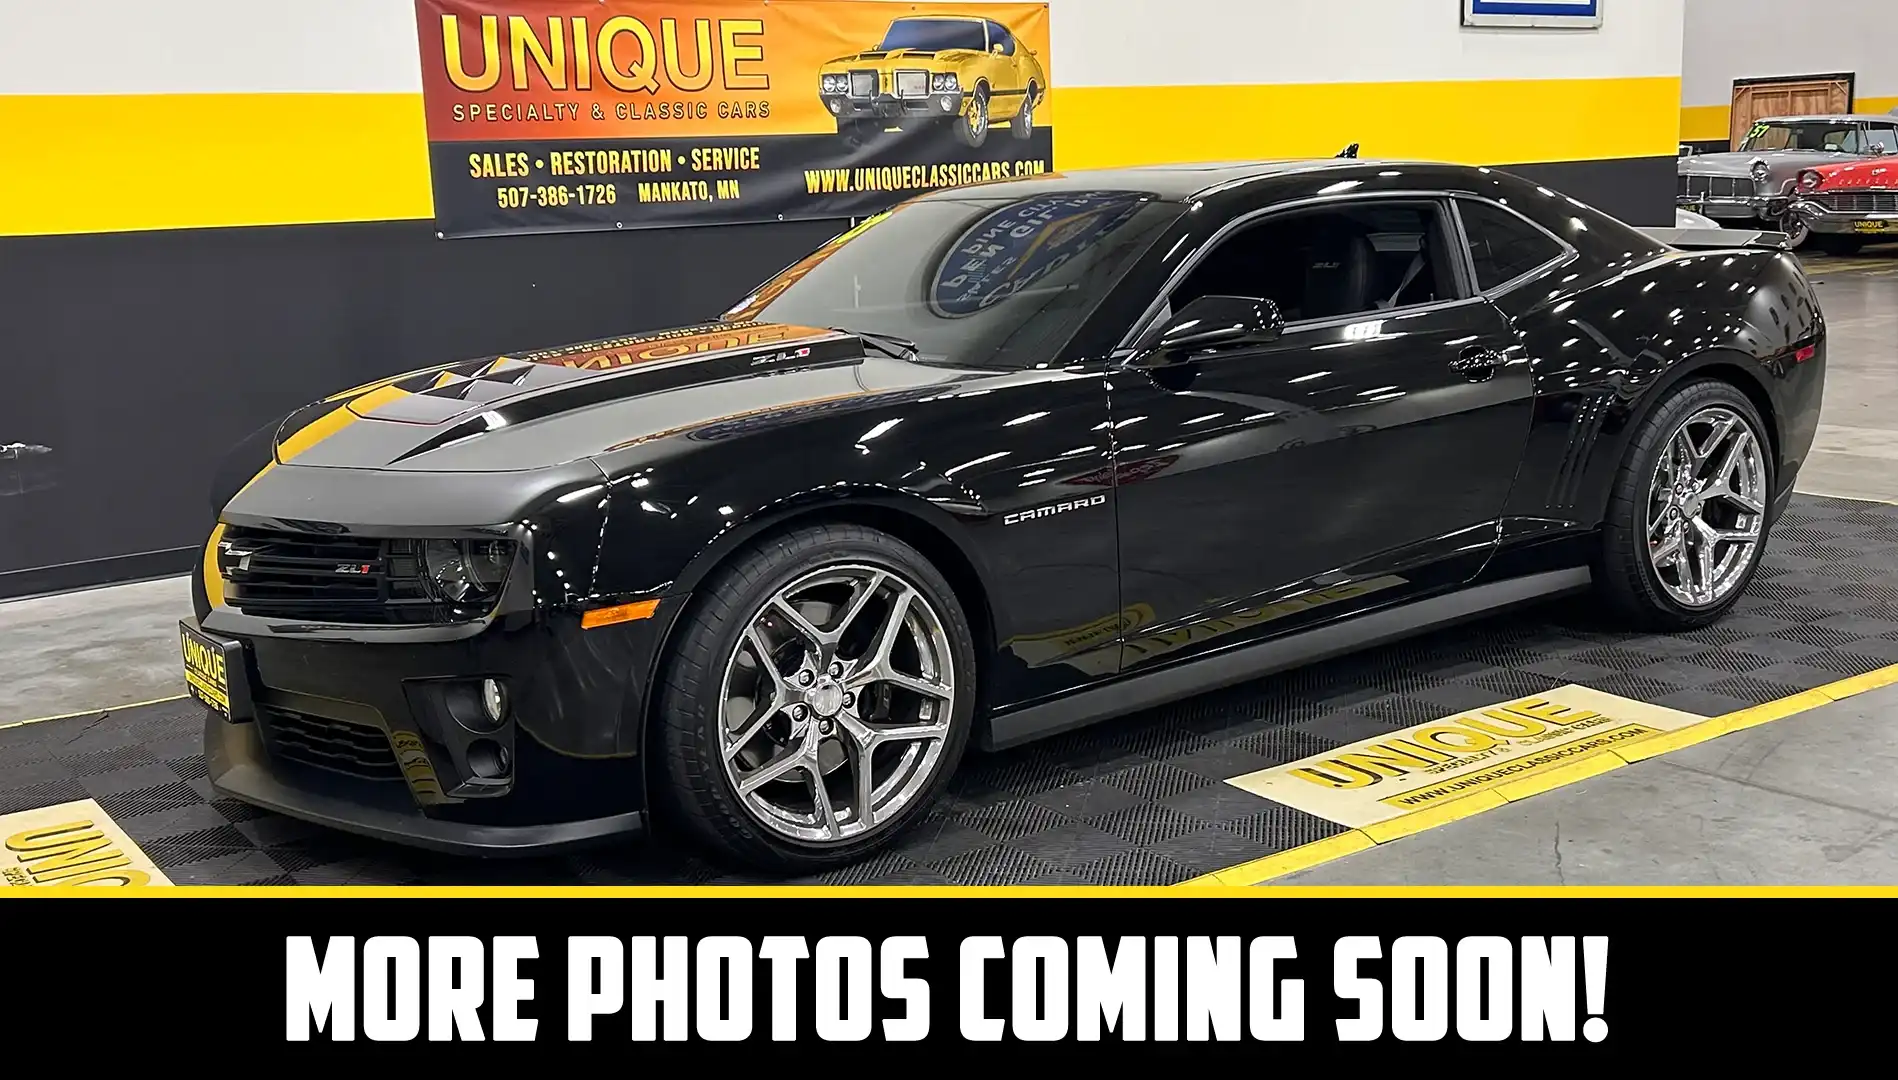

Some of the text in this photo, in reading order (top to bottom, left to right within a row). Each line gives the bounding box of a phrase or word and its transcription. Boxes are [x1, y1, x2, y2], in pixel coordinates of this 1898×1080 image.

[440, 14, 770, 94] UNIQUE
[452, 100, 771, 122] SPECIALTY & CLASSIC CARS
[468, 147, 760, 179] SALES RESTORATION SERVICE
[804, 160, 1045, 194] WWW.UNIQUECLASSICCARSCOM
[497, 179, 740, 209] 507-386-1726 MANKATO, MN
[750, 348, 810, 366] ZL1
[1004, 495, 1106, 525] CAMARO
[335, 564, 370, 574] ZL1
[182, 632, 226, 685] UNIQUE
[1286, 698, 1602, 789] UNIQUE
[1400, 727, 1649, 806] WWW.UNIQUECLASSICCARS.COM
